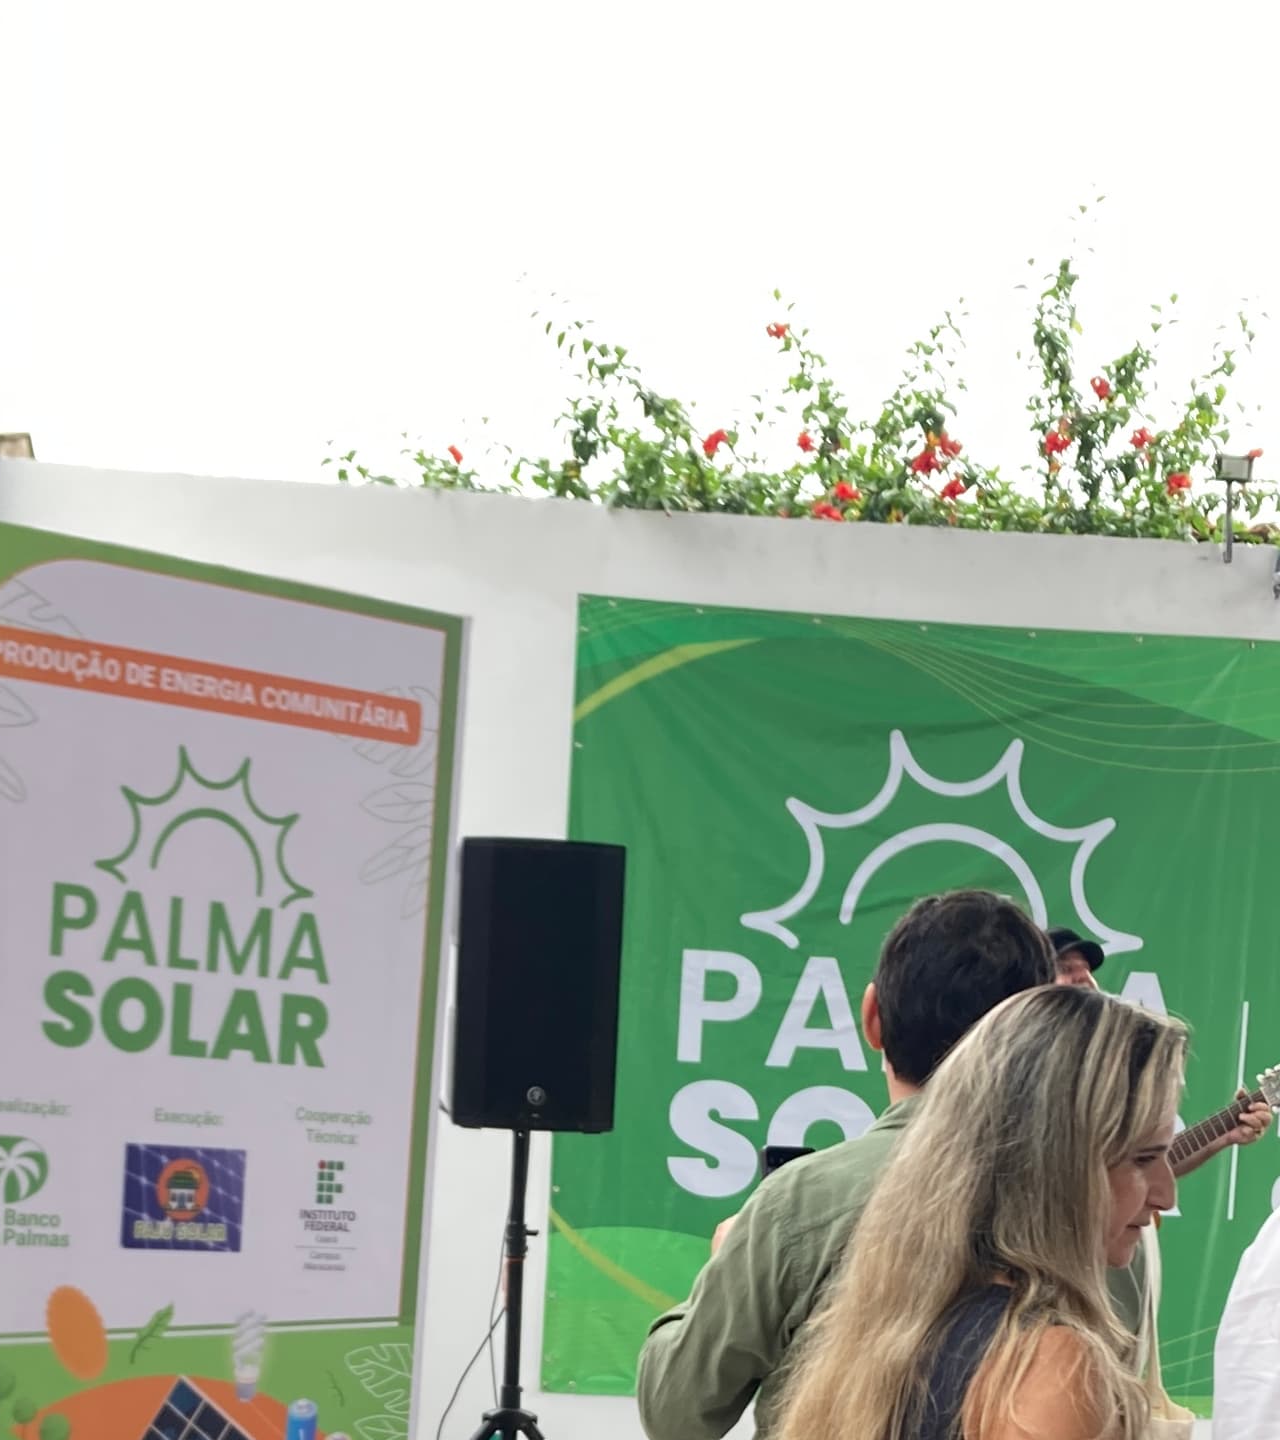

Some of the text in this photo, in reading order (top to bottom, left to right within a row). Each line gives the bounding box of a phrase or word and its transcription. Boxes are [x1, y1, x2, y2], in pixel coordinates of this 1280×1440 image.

[125, 661, 158, 689] DE
[160, 666, 257, 706] ENERGIA
[261, 685, 410, 733] COMUNITÁRIA
[49, 881, 329, 984] PALMA
[41, 970, 329, 1068] SOLAR
[4, 1208, 61, 1227] Banco
[299, 1209, 356, 1221] INSTITUTO
[304, 1221, 351, 1232] FEDERAL
[3, 1228, 69, 1247] Palmas
